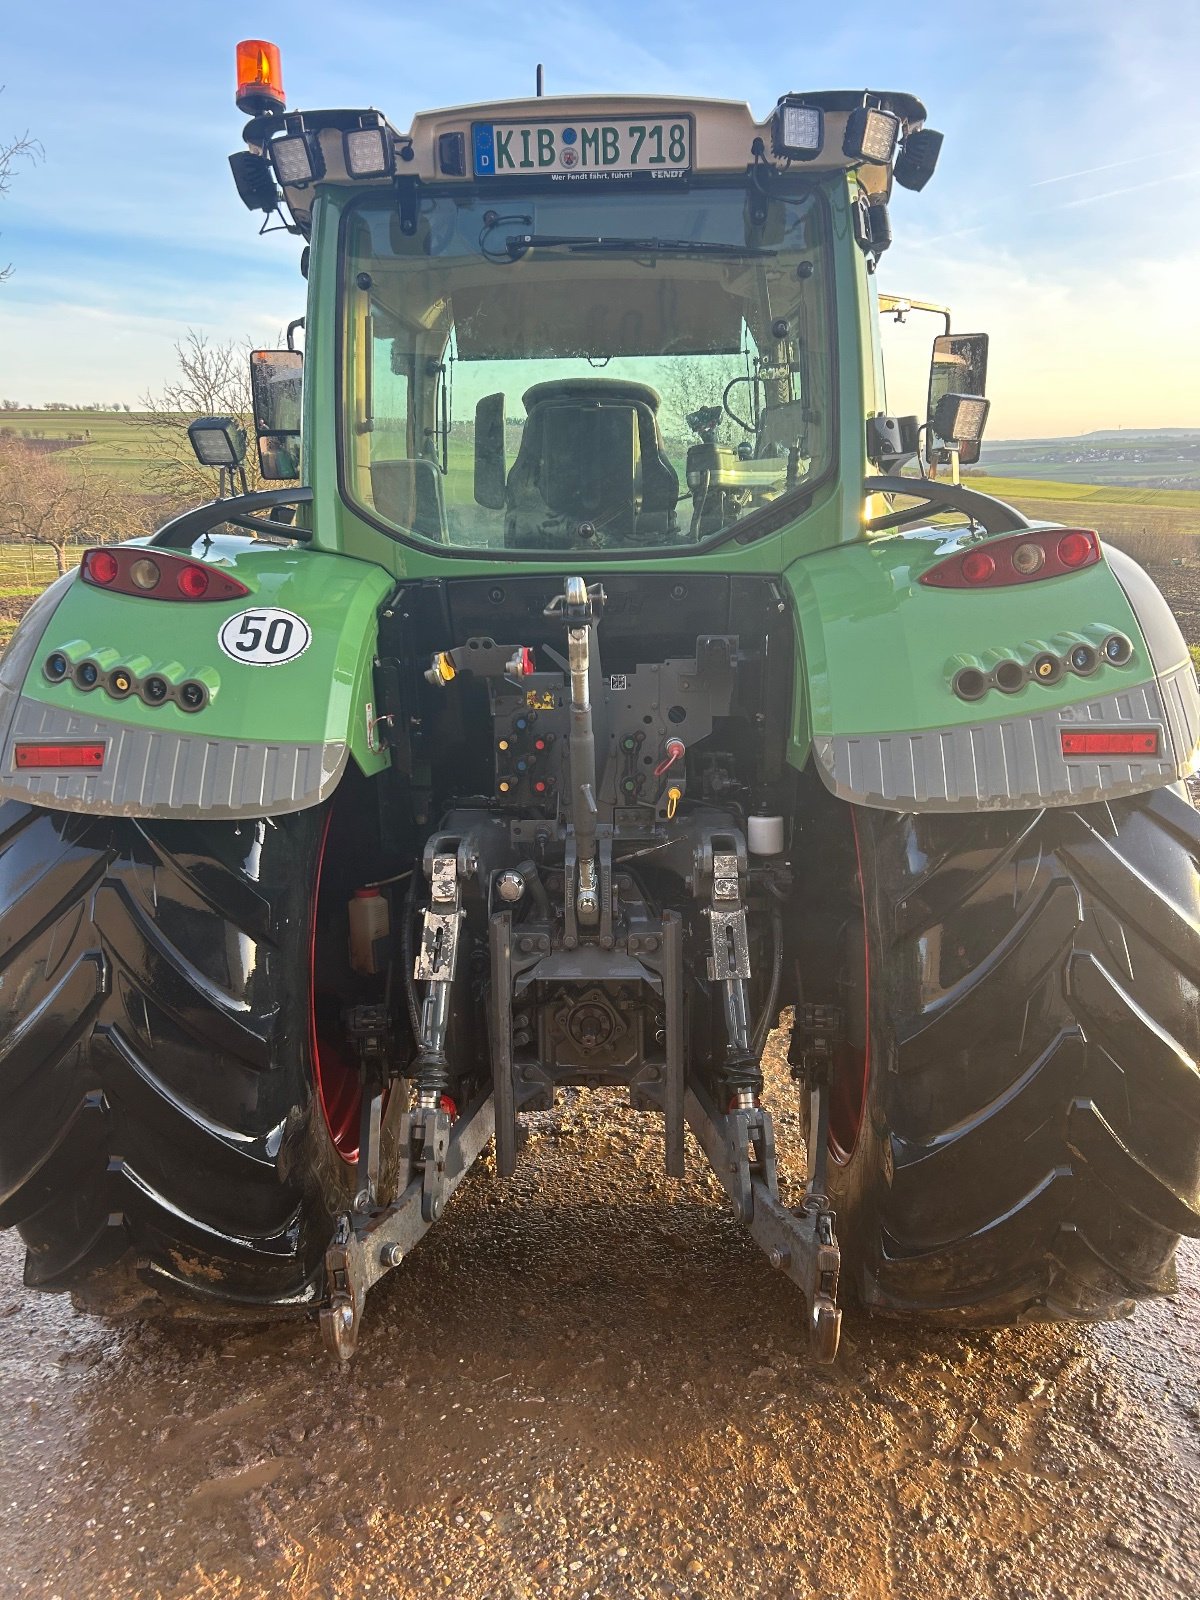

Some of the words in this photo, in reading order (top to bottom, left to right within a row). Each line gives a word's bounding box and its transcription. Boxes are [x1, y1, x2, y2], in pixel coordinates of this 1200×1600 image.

[496, 128, 556, 169] KIB
[581, 126, 620, 166] MB
[628, 124, 686, 164] 718
[481, 155, 489, 166] D
[651, 170, 685, 179] FENDT
[235, 615, 294, 655] 50
